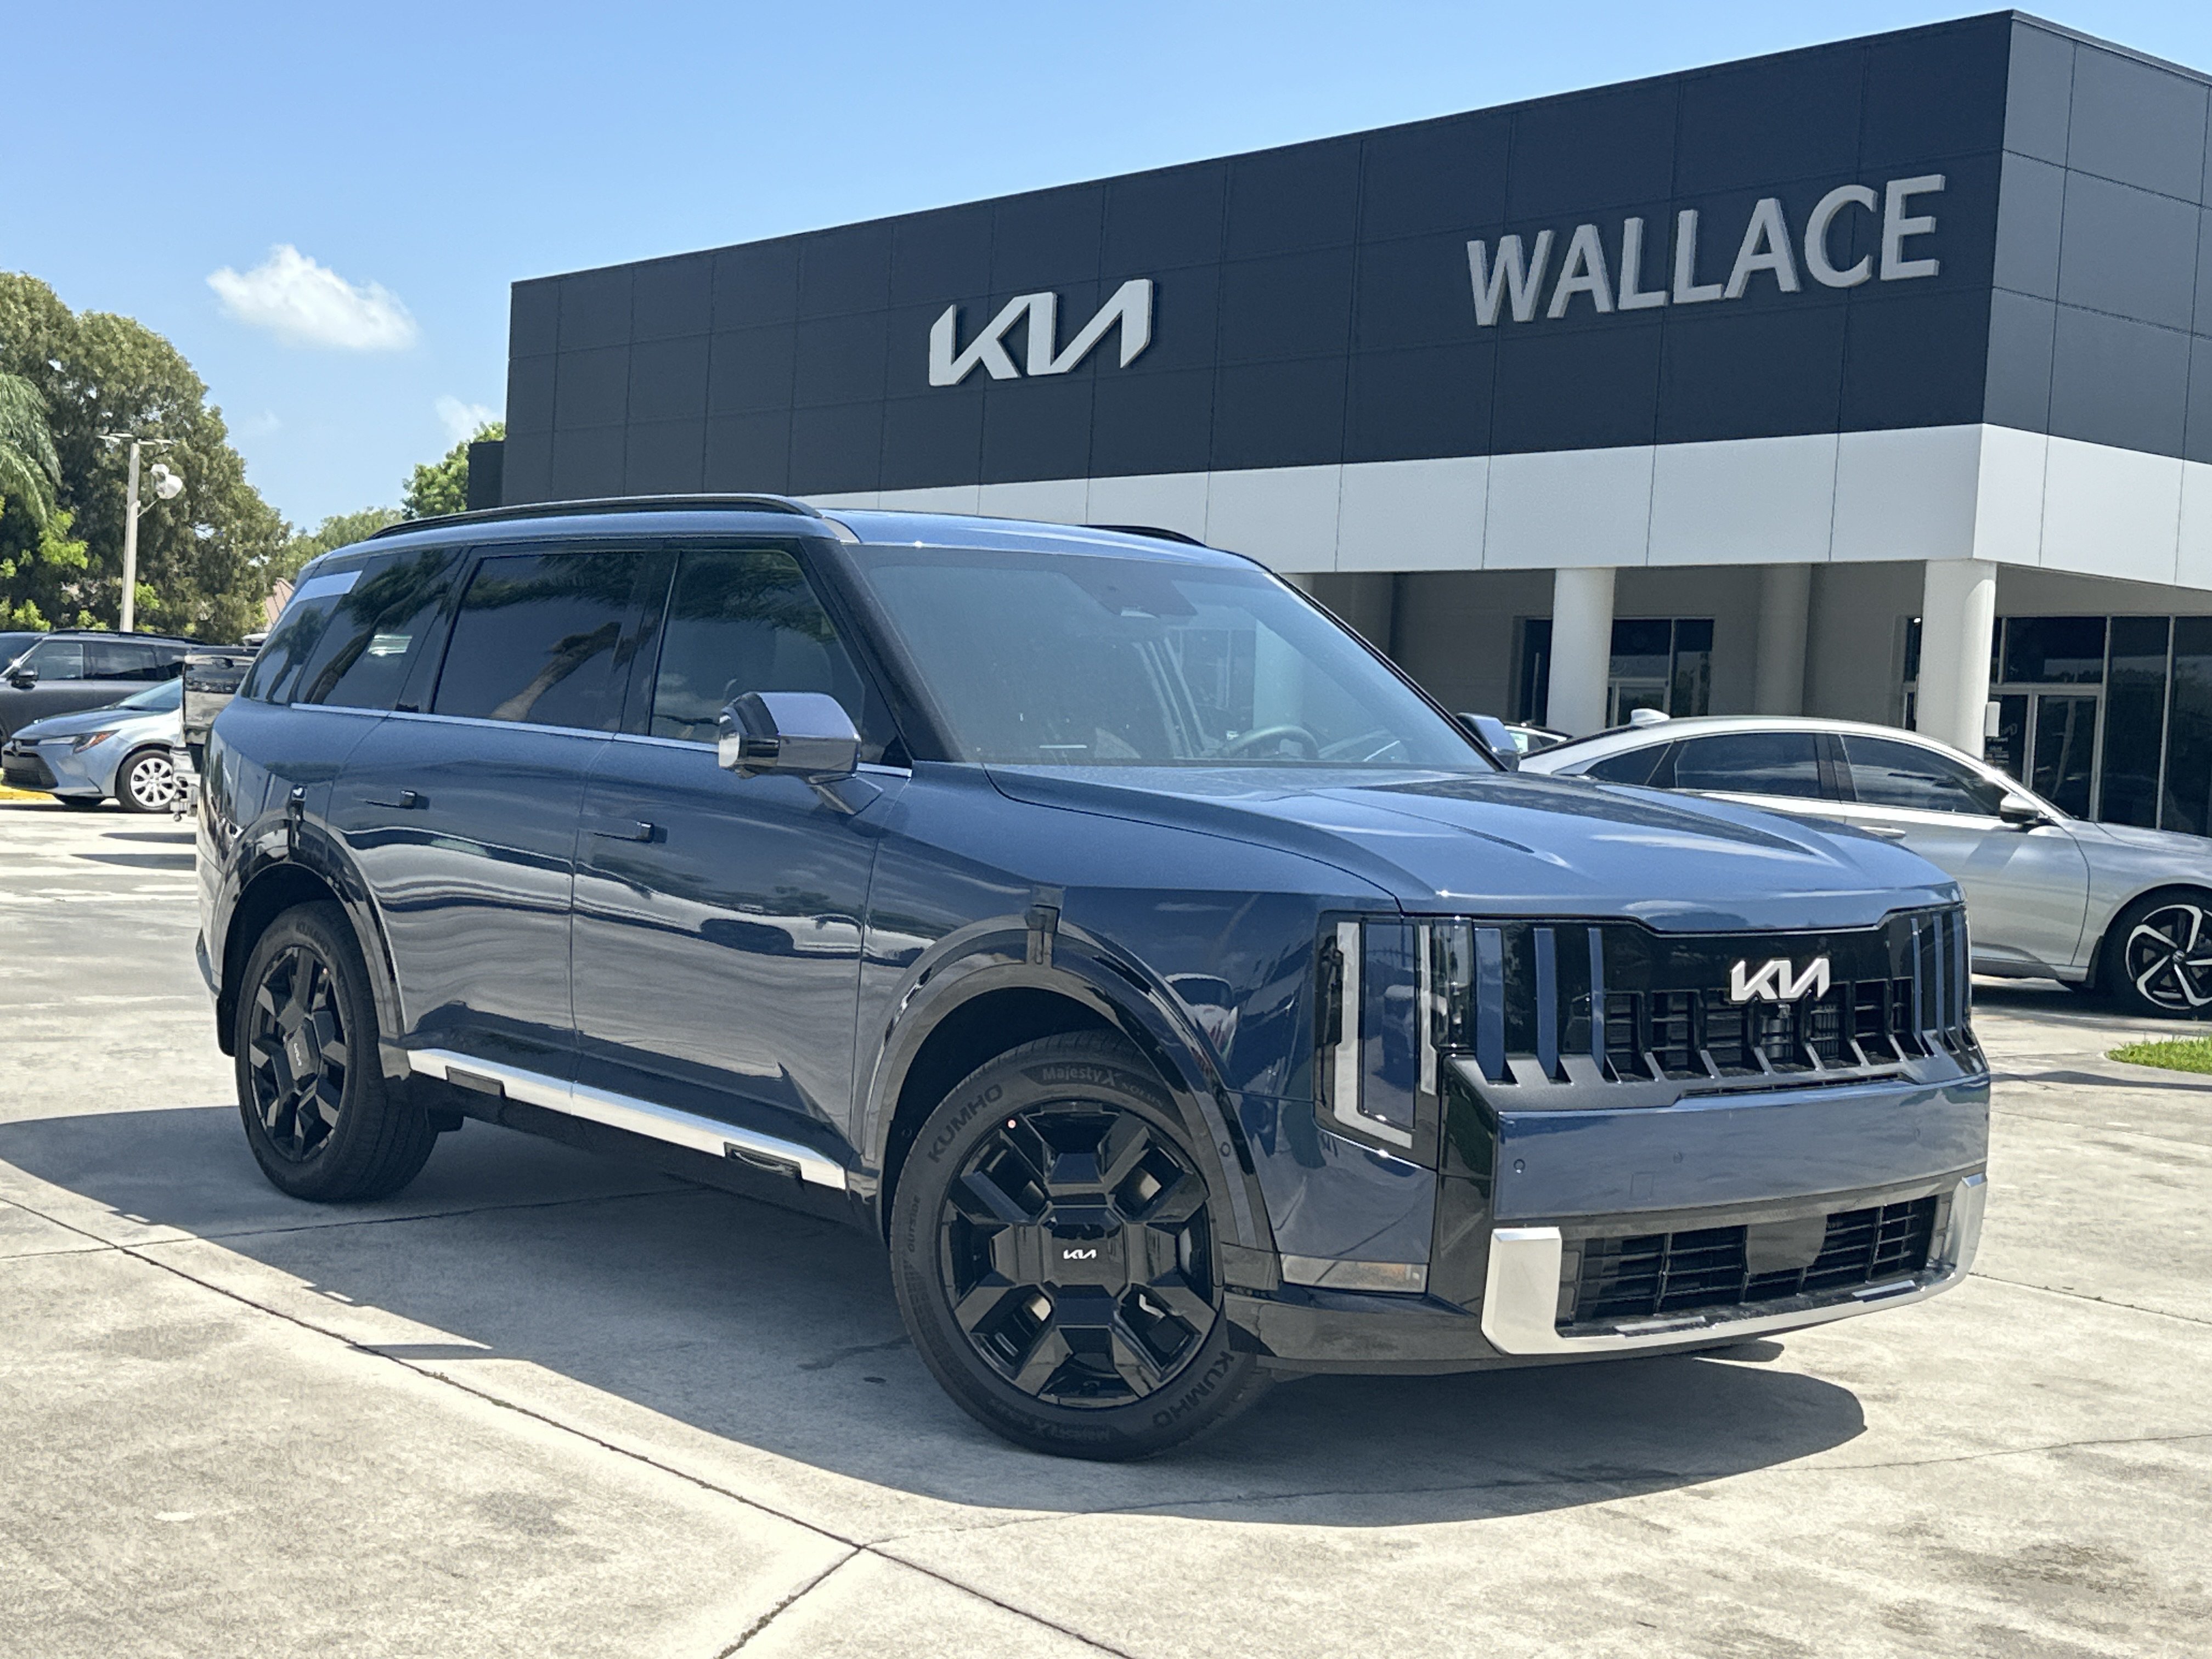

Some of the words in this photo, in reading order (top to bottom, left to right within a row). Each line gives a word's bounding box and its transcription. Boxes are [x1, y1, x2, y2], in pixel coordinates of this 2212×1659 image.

[1466, 174, 1946, 327] WALLACE
[928, 278, 1154, 387] KIA
[1730, 958, 1830, 1004] KIA
[928, 1084, 1003, 1163] KUMHO
[1064, 1249, 1097, 1259] KIA
[1153, 1351, 1234, 1426] KUMHO
